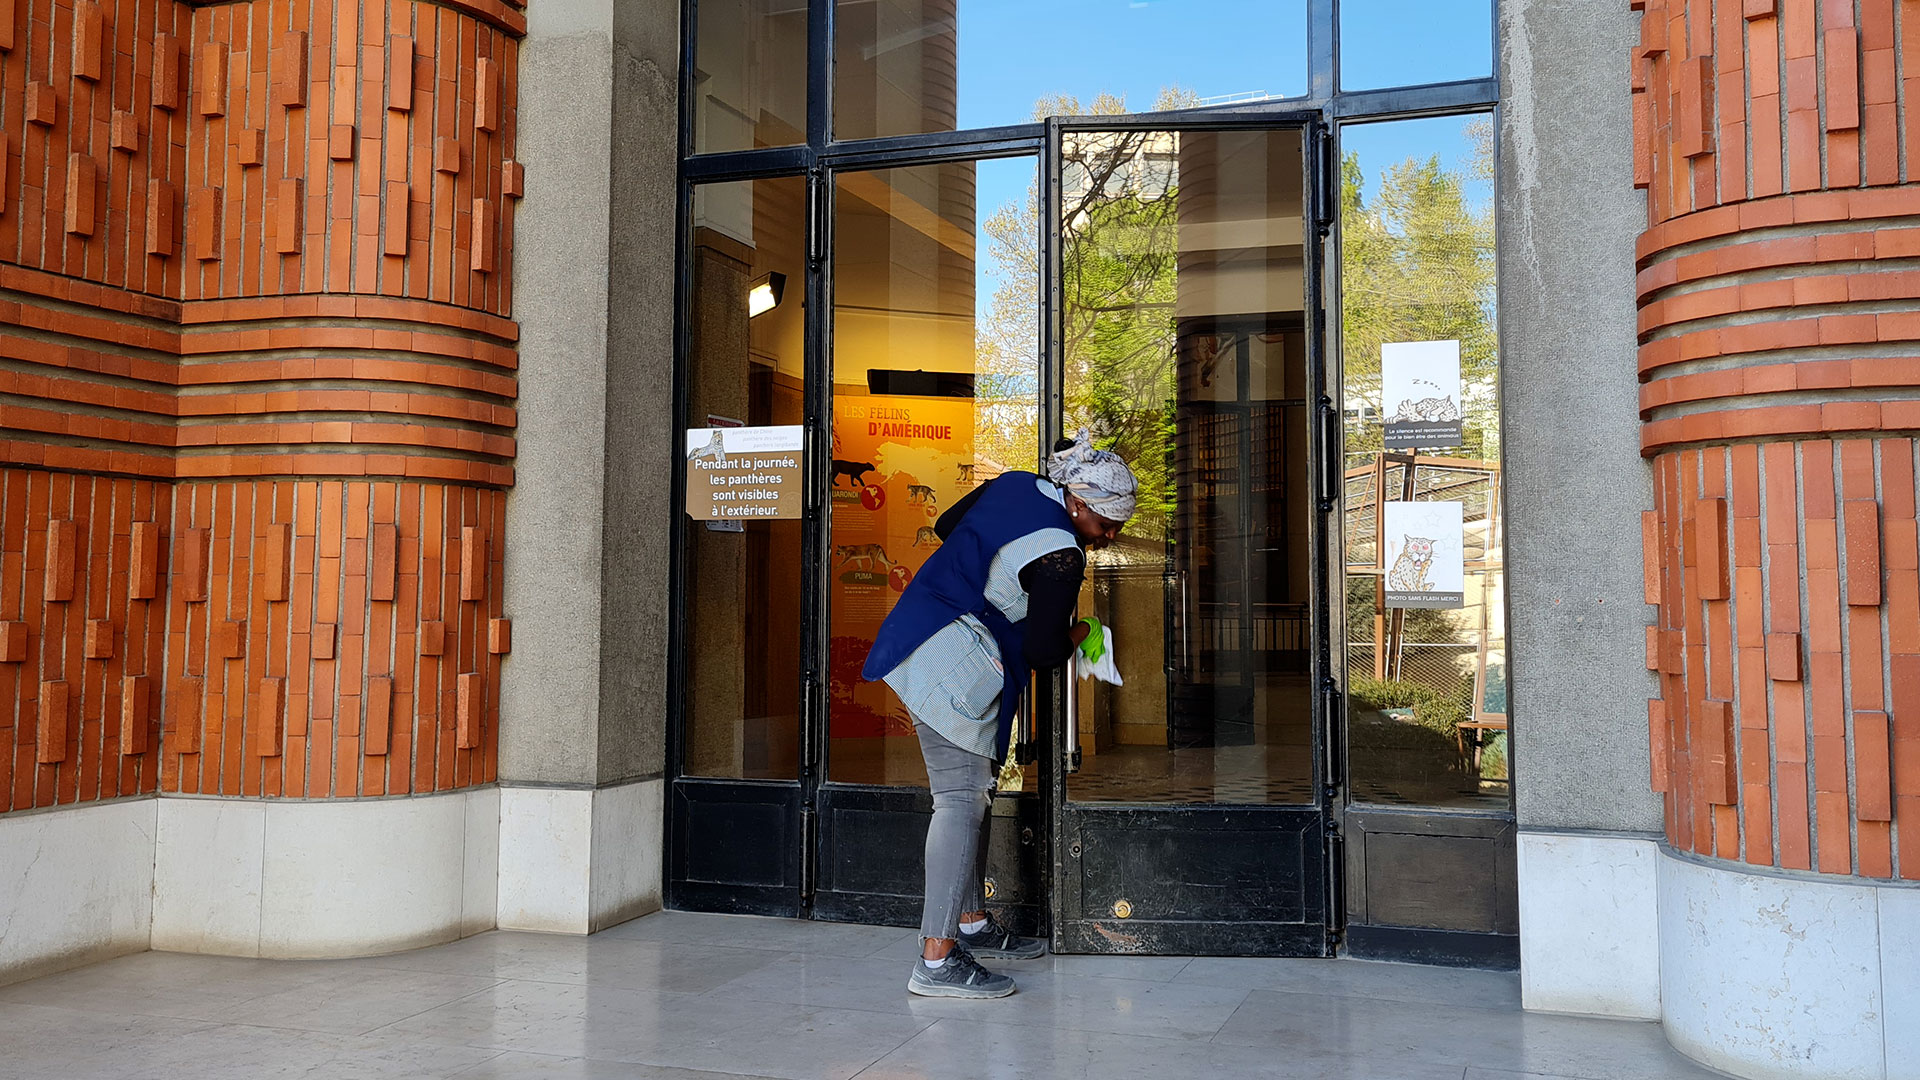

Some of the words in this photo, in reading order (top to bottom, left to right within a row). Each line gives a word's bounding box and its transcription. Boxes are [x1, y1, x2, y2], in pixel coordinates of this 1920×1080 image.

[843, 405, 865, 418] LES
[869, 404, 910, 420] FÉLINS
[695, 459, 739, 470] Pendant
[741, 458, 751, 468] la
[753, 455, 798, 471] journée,
[710, 474, 726, 485] les
[728, 472, 782, 487] panthères
[712, 490, 736, 500] sont
[738, 488, 779, 500] visibles
[831, 490, 859, 499] UARONDI
[711, 505, 718, 516] à
[854, 572, 873, 580] PUMA
